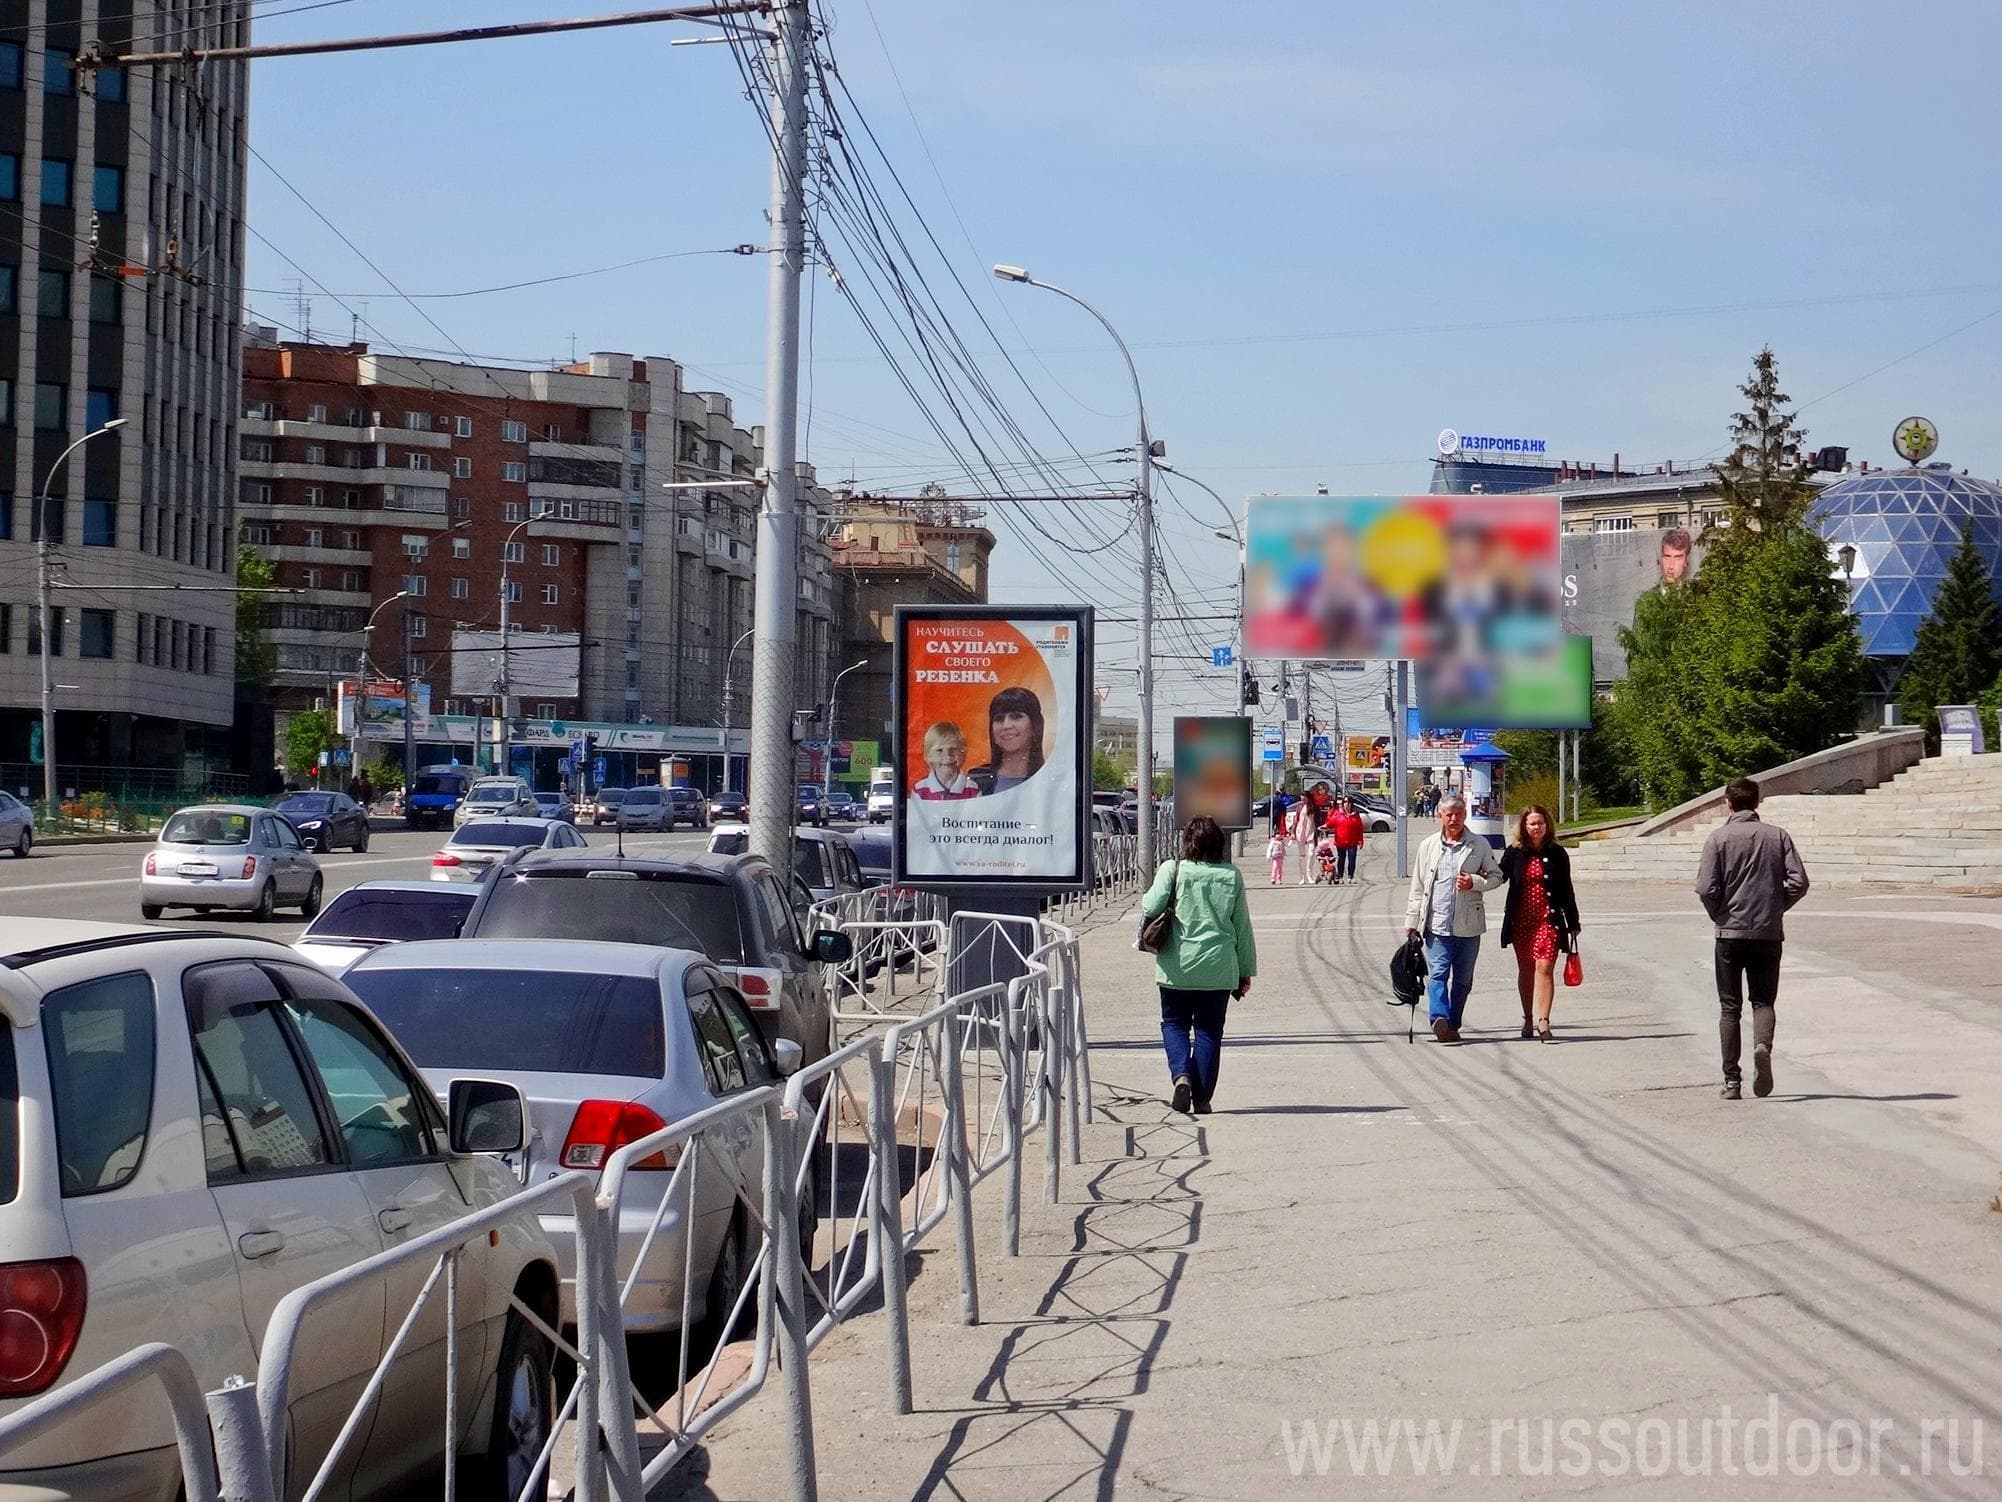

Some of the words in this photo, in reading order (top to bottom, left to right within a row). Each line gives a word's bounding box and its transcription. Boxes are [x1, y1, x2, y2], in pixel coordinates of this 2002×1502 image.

[1461, 436, 1546, 452] ГАЗПРОМБАНК
[916, 626, 985, 637] НАУЧИТЕСЬ
[925, 640, 1020, 654] СЛУШАТЬ
[945, 656, 991, 667] СВОЕГО
[915, 670, 1000, 683] РЕБЕНКА
[942, 817, 1022, 829] Воспитание
[929, 834, 951, 844] это
[955, 834, 999, 846] всегда
[1003, 834, 1054, 846] диалог!
[955, 860, 1026, 869] www.ya-roditel.ru
